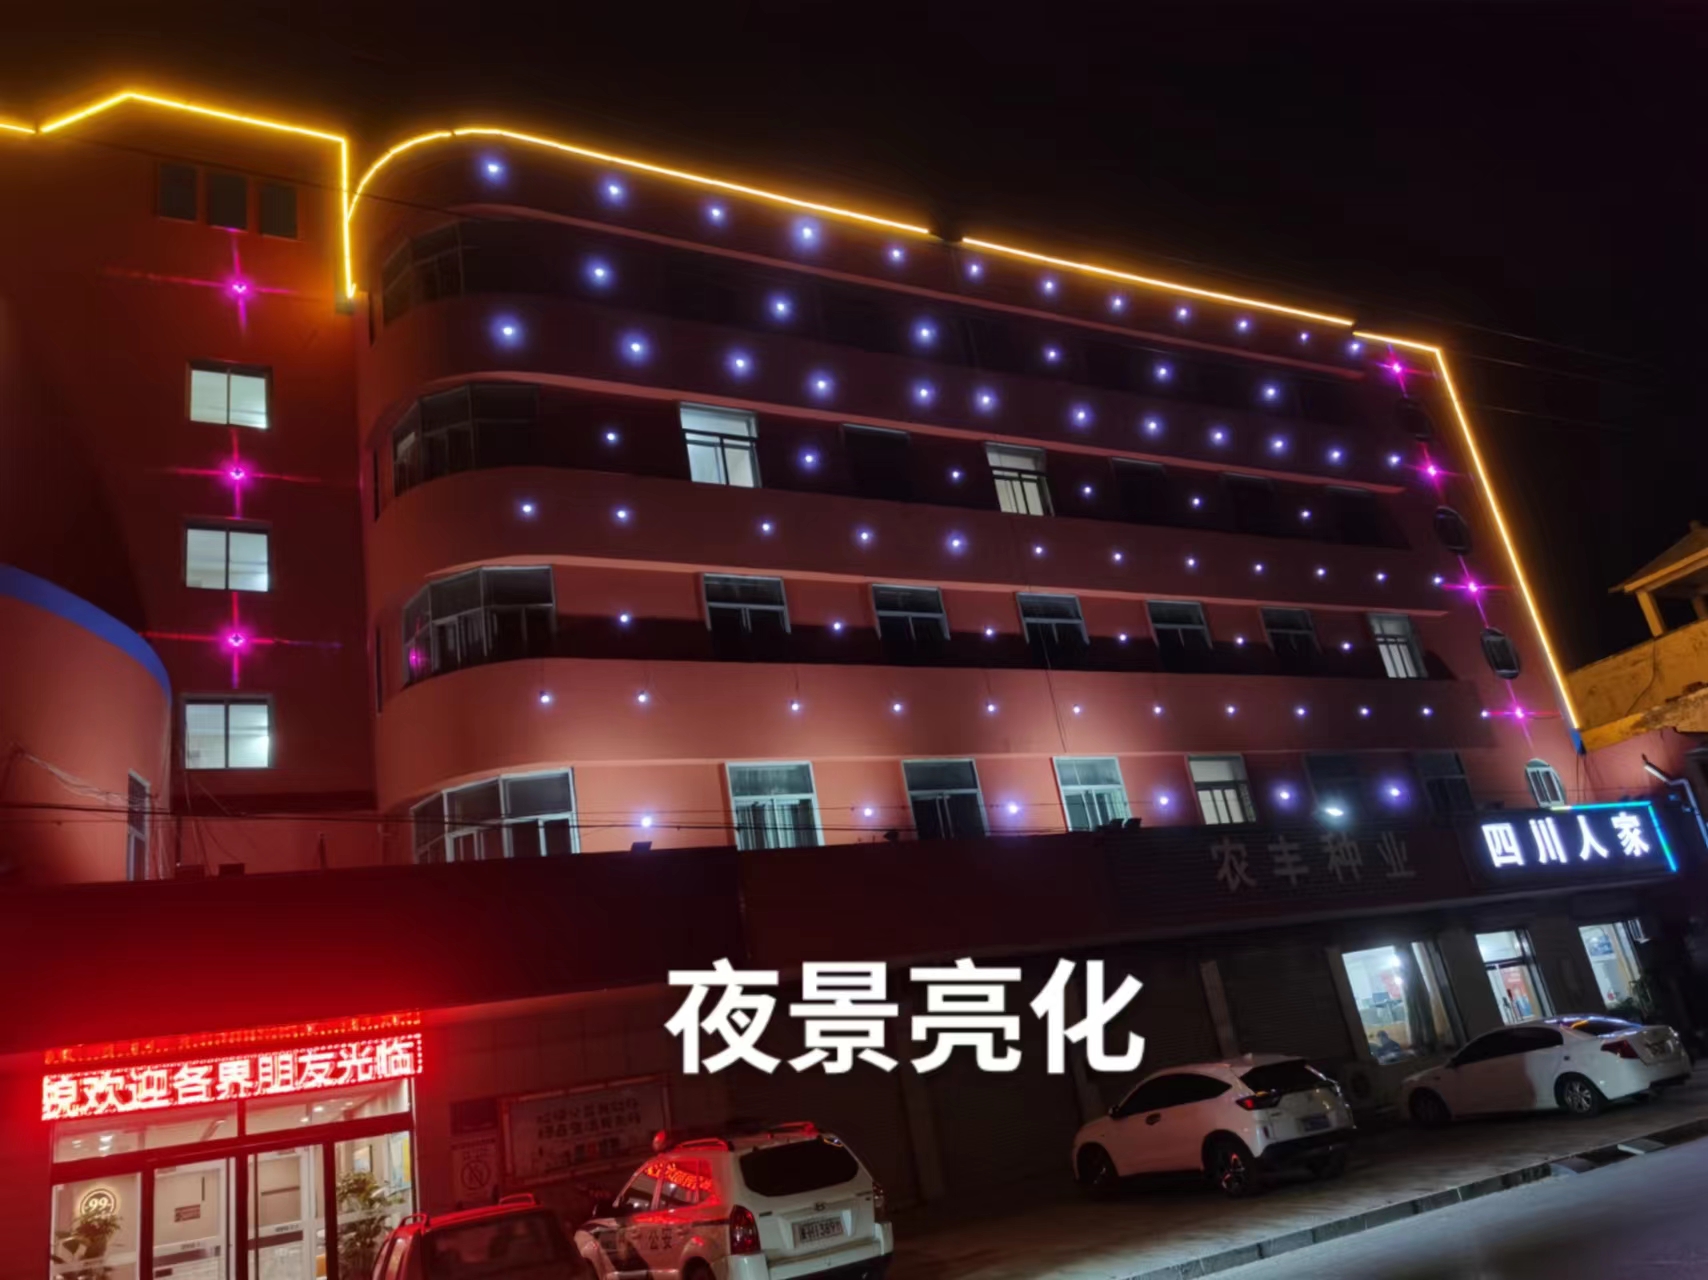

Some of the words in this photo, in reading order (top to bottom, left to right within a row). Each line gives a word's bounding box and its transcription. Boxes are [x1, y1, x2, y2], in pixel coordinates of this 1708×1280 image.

[1210, 830, 1416, 892] 农丰种业
[1481, 811, 1652, 868] 四川人家
[648, 1229, 673, 1250] 公安
